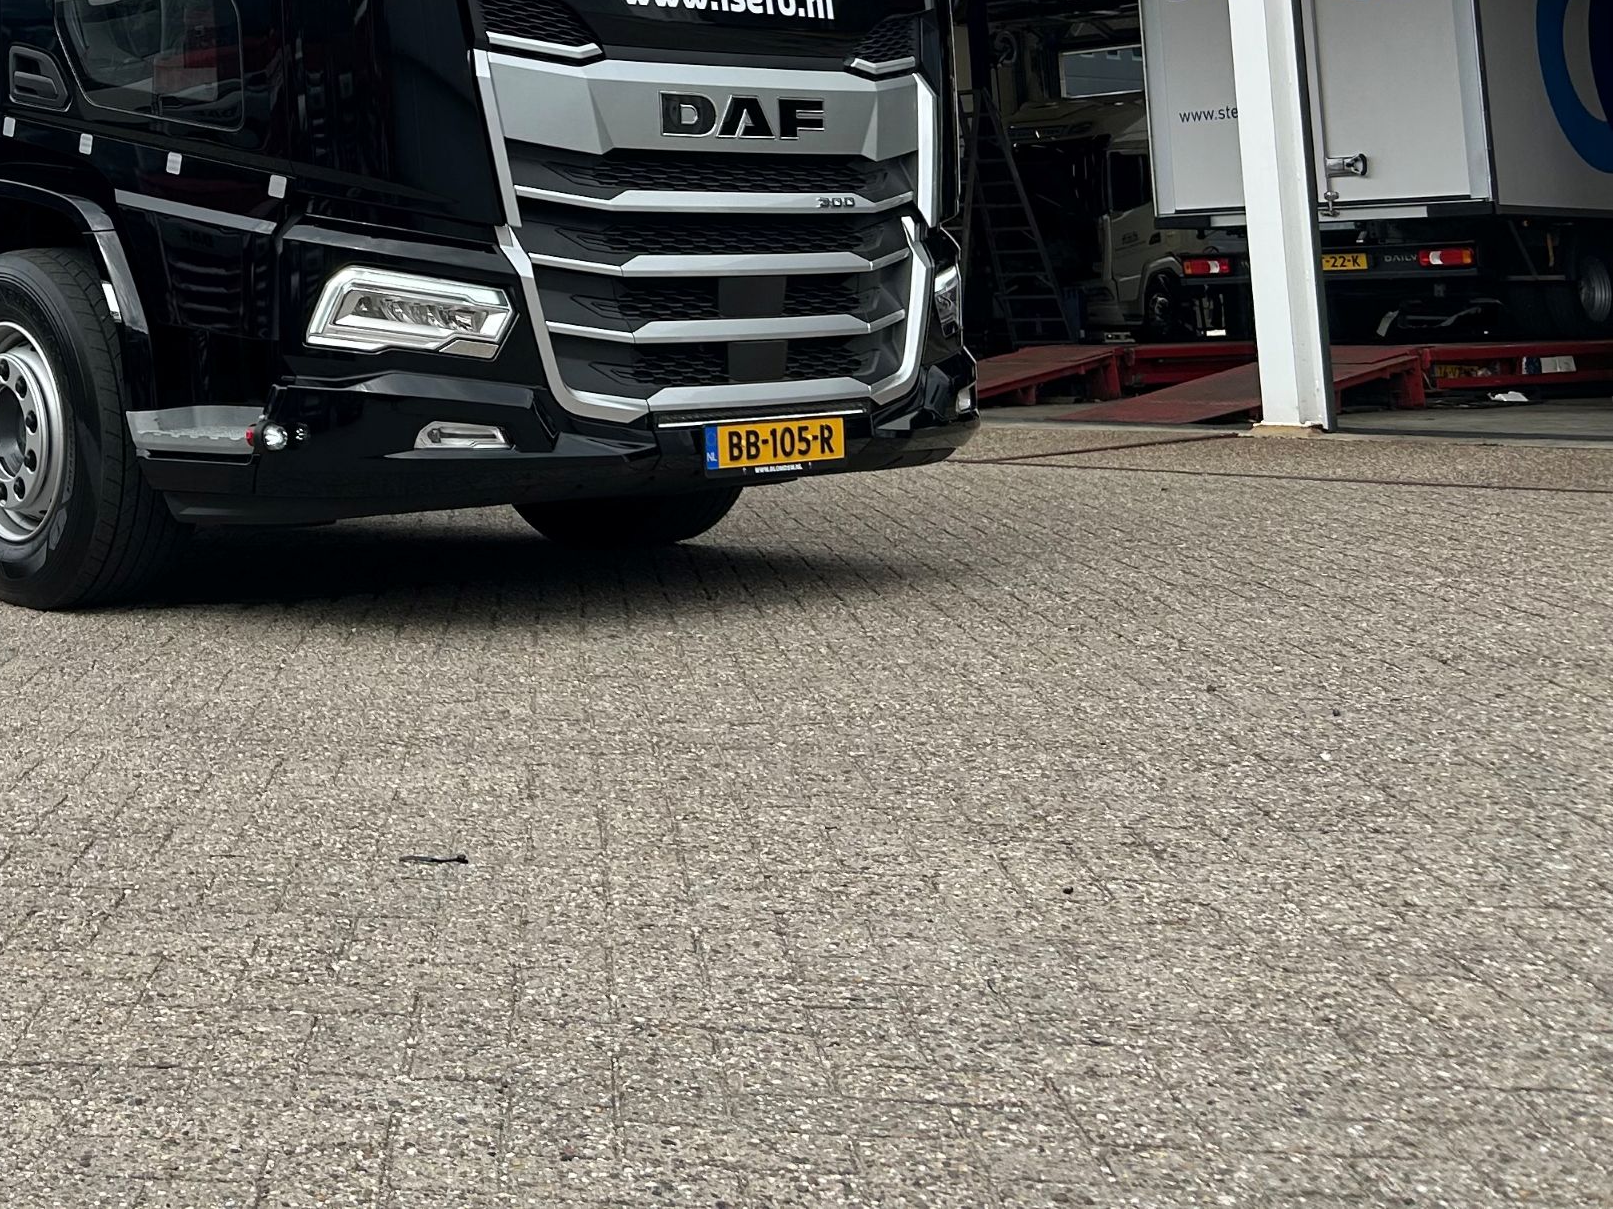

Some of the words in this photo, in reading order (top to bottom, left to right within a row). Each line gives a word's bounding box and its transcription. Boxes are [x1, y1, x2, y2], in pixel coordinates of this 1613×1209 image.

[658, 90, 826, 141] DAF
[817, 196, 855, 208] 300
[1322, 255, 1361, 268] -22-K
[728, 424, 834, 461] BB-105-R
[706, 451, 717, 462] NL
